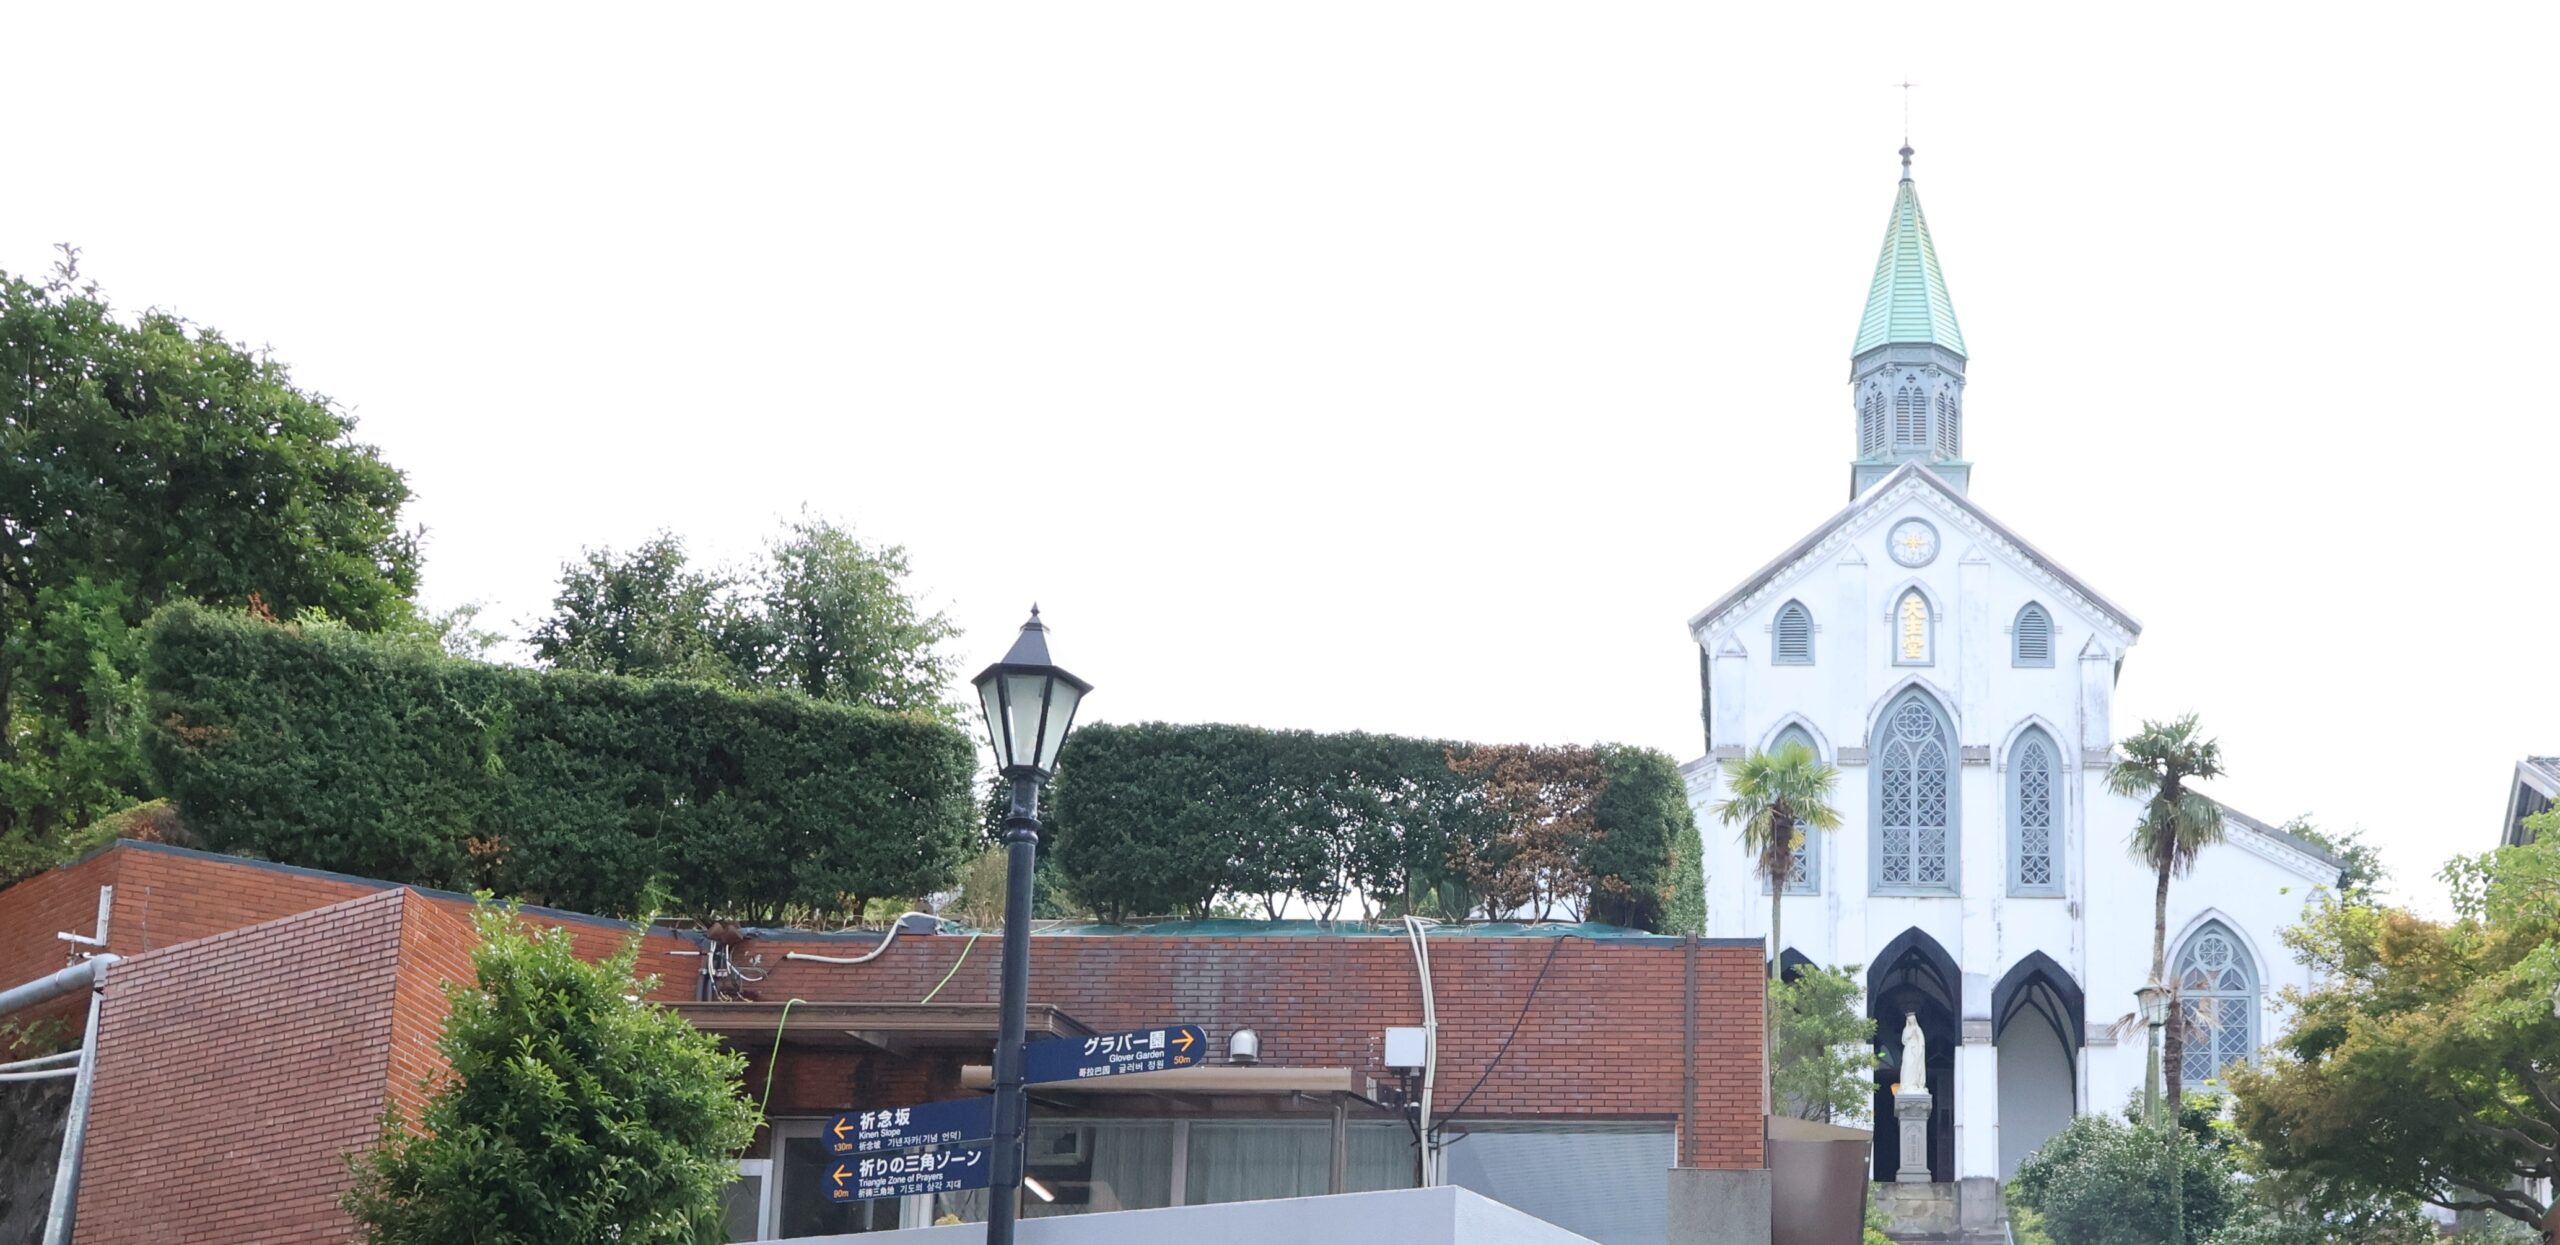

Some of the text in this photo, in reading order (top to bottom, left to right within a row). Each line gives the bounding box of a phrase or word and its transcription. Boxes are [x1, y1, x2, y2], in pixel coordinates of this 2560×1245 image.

[1901, 598, 1926, 659] 天主堂
[1084, 1030, 1165, 1056] グラバー園
[1109, 1050, 1164, 1063] Glover Garden
[1173, 1055, 1191, 1065] 50m
[1118, 1060, 1164, 1074] 글러버 정원
[859, 1108, 911, 1130] 祈念坂
[858, 1128, 901, 1140] Kinen Slope
[833, 1142, 853, 1151] 130m
[859, 1151, 982, 1177] 祈りの三角ゾーン
[858, 1172, 944, 1188] Triangle Zone of Prayers
[900, 1179, 962, 1194] 기도의 삼각 지대
[833, 1189, 849, 1199] 90m
